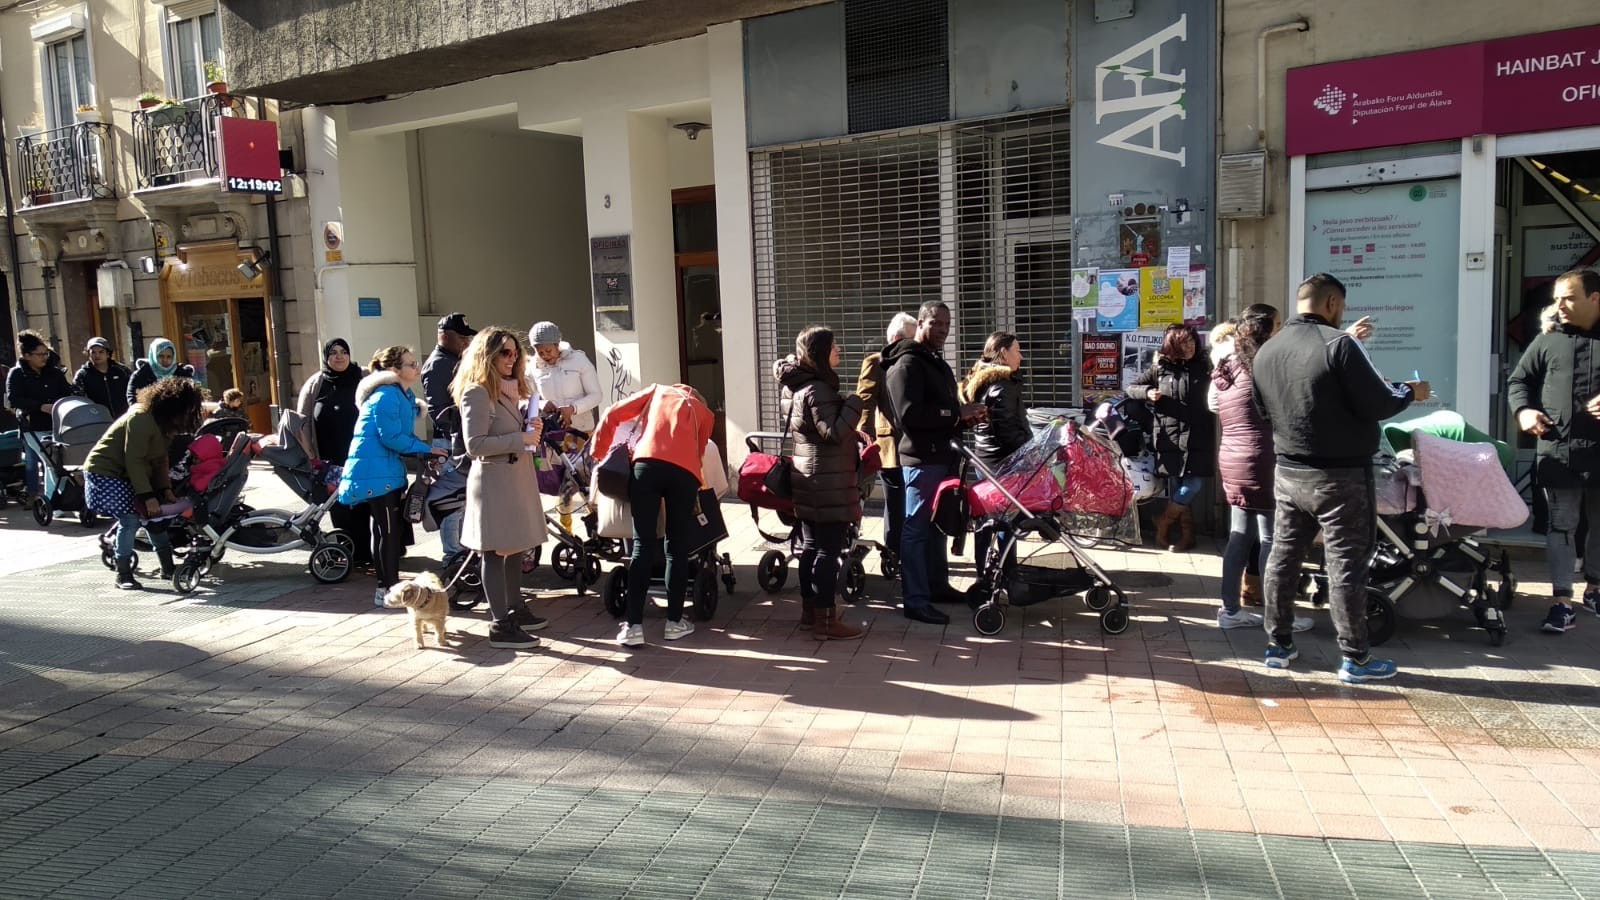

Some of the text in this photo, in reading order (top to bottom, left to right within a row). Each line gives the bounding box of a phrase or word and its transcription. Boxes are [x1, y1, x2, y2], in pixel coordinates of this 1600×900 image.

[1496, 51, 1586, 77] HAINBAT
[1096, 13, 1187, 167] AFA
[1352, 90, 1443, 108] Arabako Foru Aldundia
[1352, 98, 1452, 118] Diputación Foral de Álava
[228, 177, 282, 192] 12:19:02
[604, 194, 612, 209] 3
[188, 265, 240, 288] Tabacos
[1084, 342, 1116, 350] BAD SOUND
